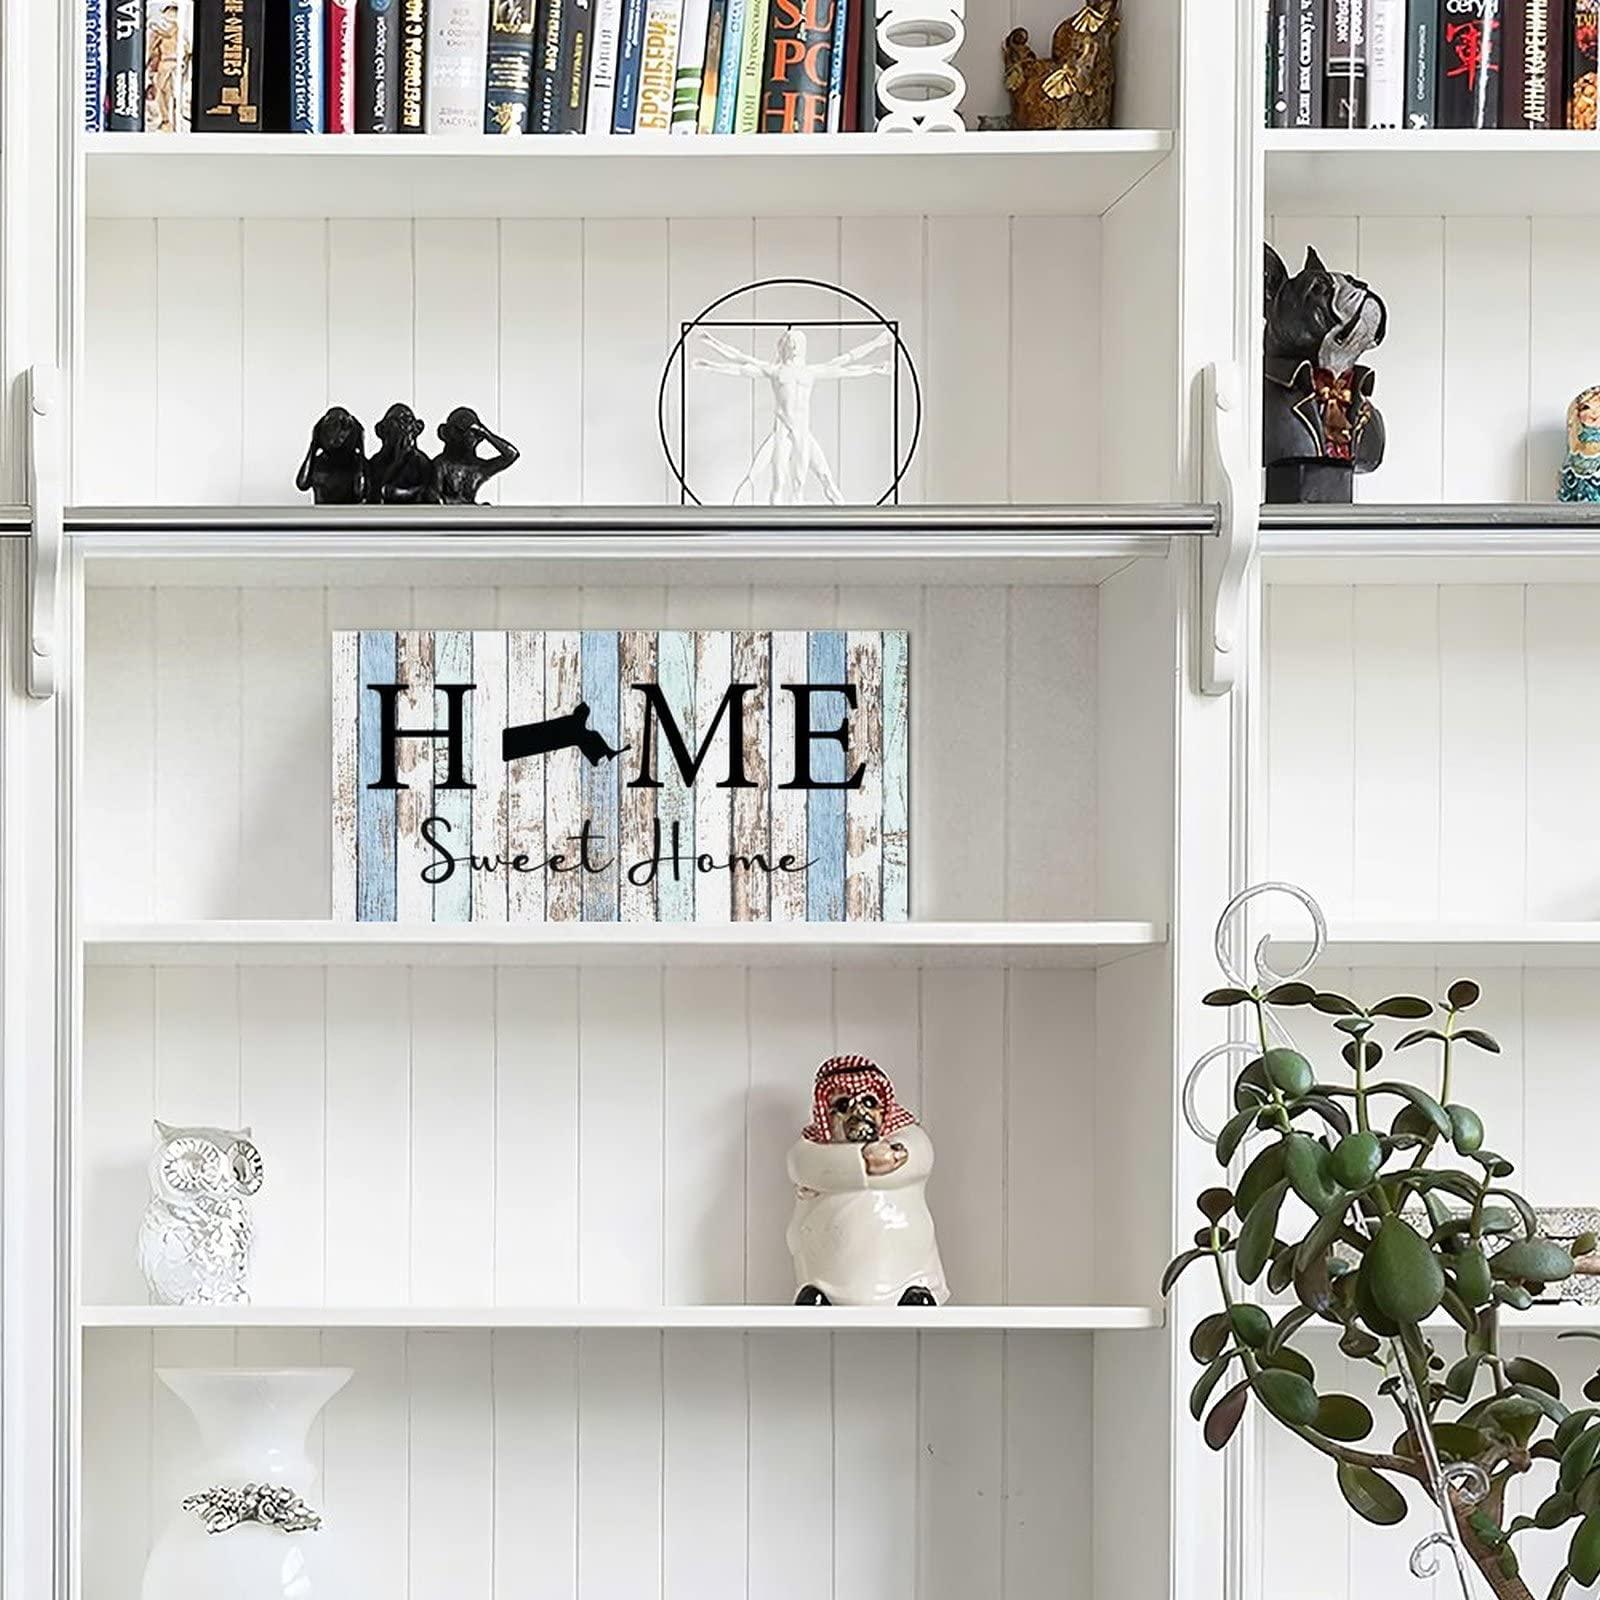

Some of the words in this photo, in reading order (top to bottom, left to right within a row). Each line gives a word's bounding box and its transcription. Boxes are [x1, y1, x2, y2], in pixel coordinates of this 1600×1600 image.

[1523, 78, 1546, 122] АННА
[421, 817, 615, 884] Sweet
[627, 818, 819, 887] Home
